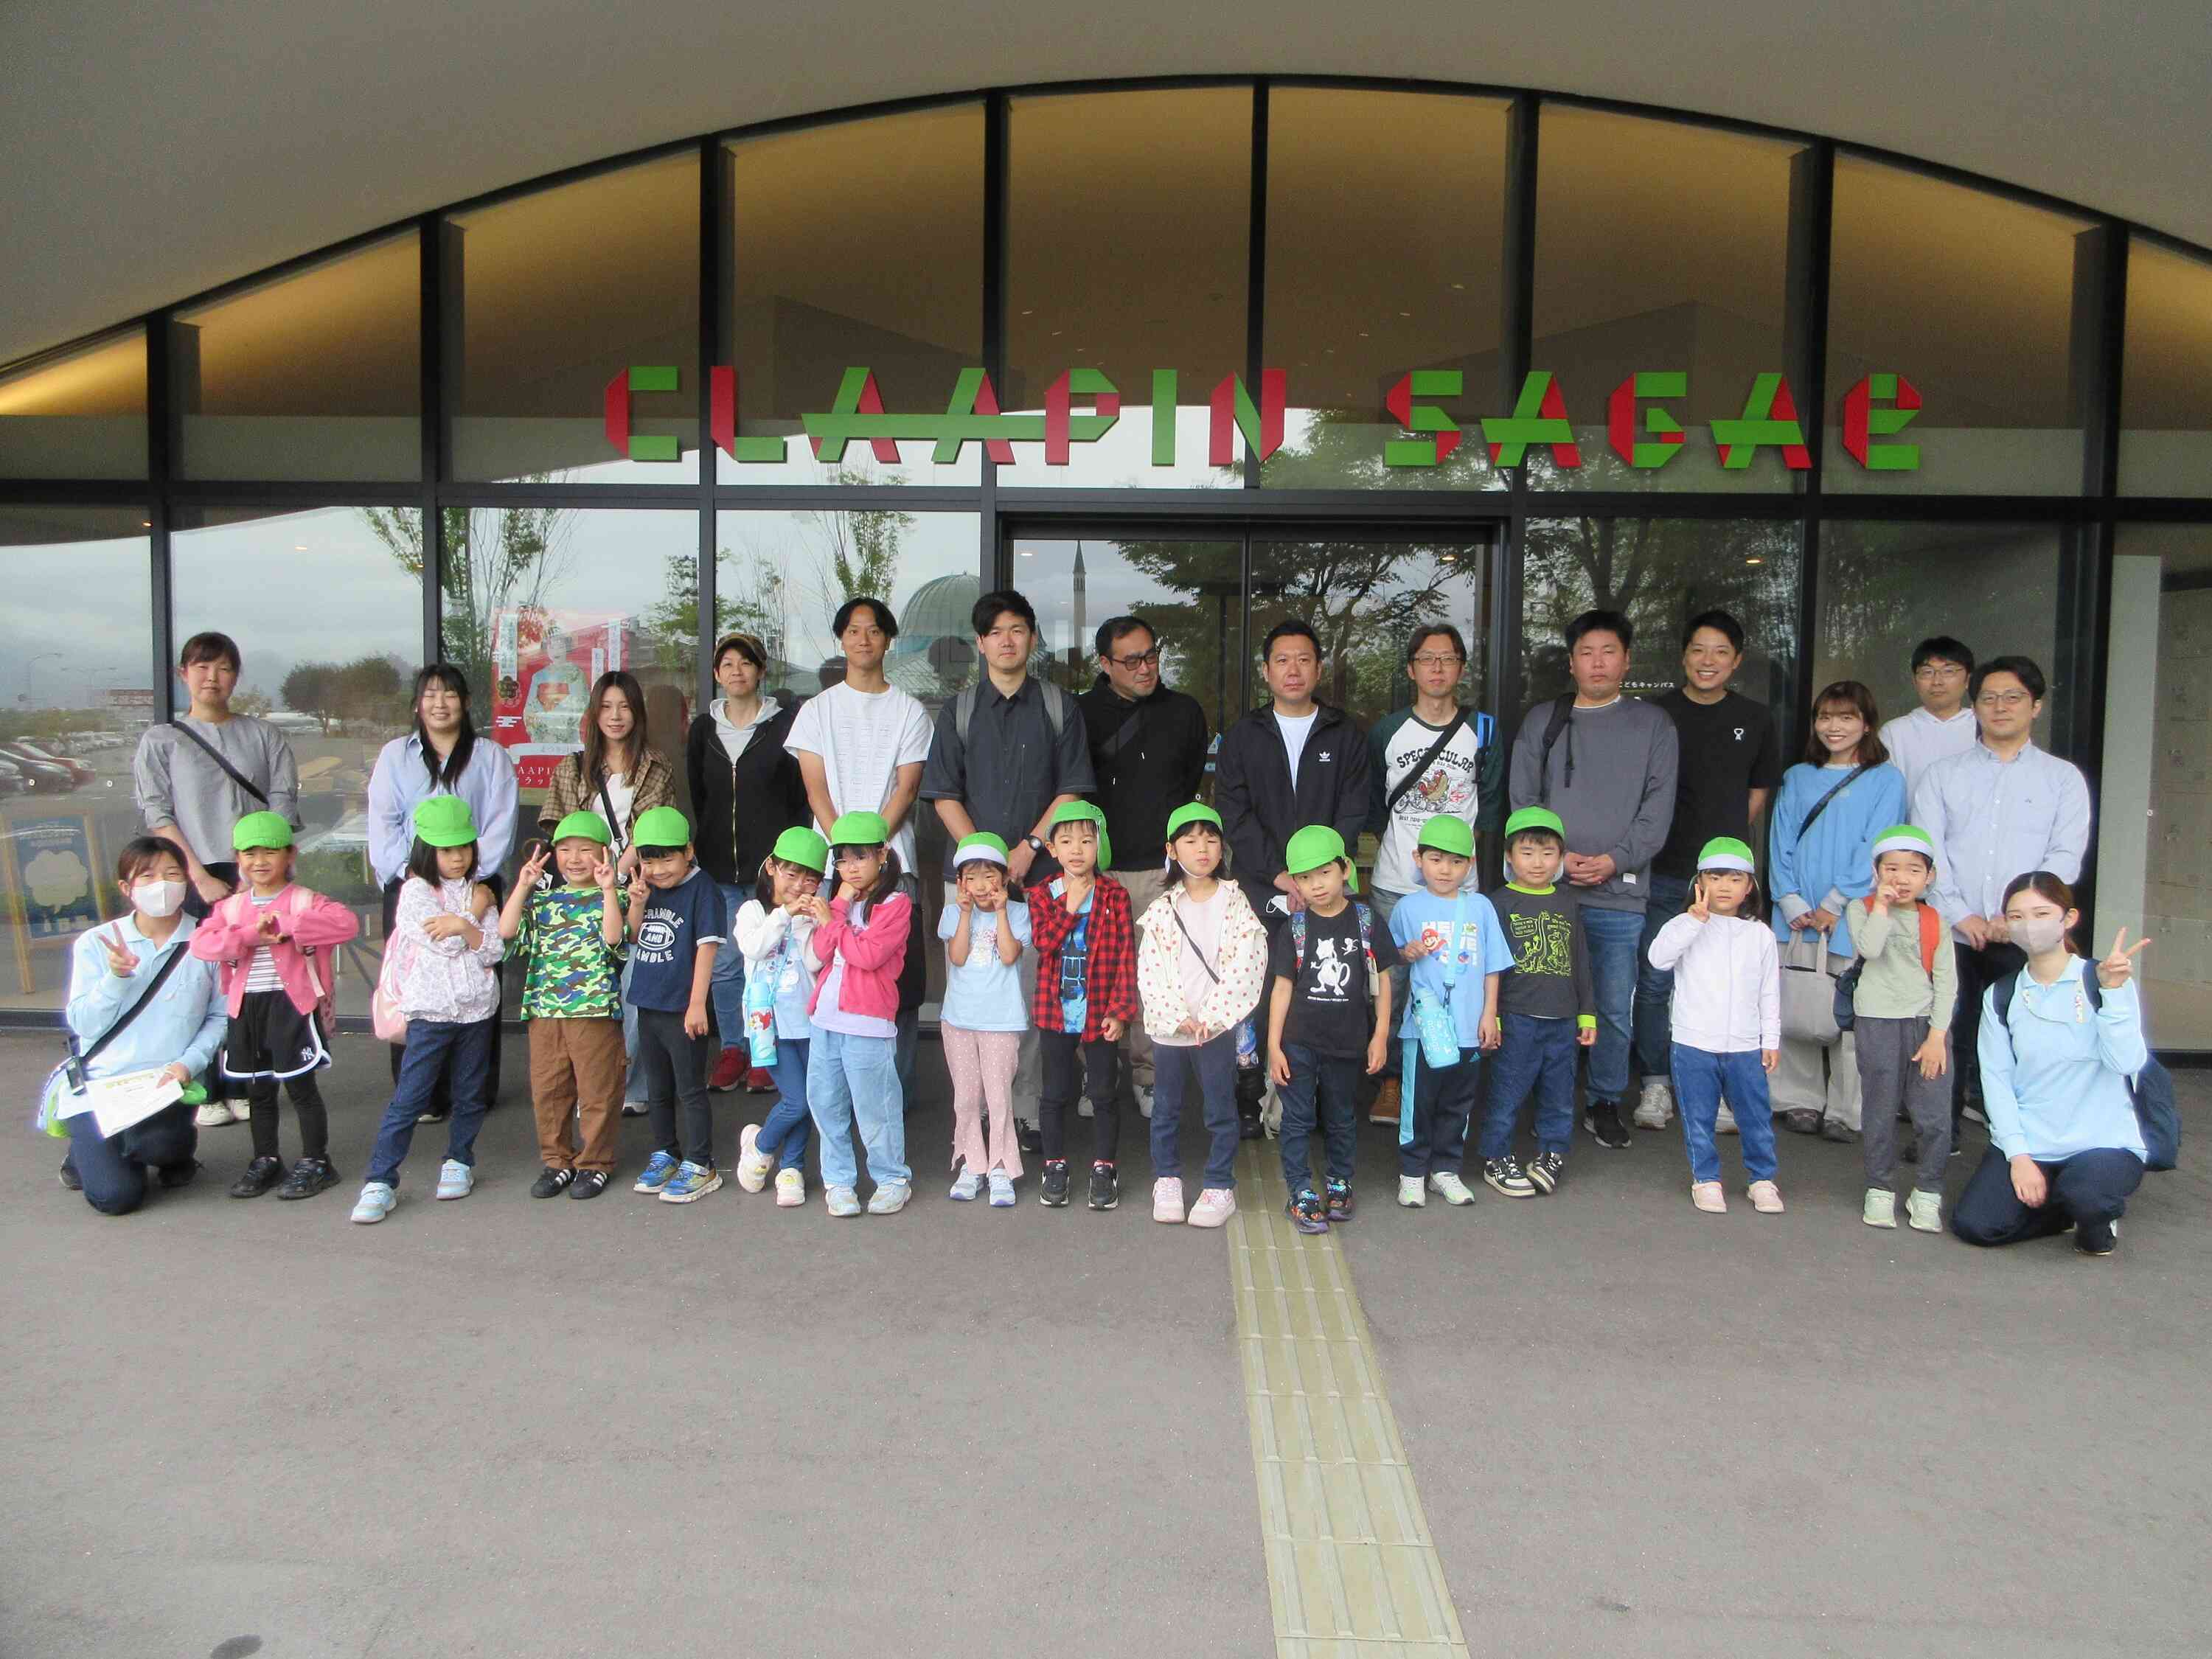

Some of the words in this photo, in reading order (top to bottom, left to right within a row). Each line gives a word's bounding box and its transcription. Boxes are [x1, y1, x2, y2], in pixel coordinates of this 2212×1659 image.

[605, 366, 1287, 466] CLAAPIN
[1397, 748, 1474, 773] SPECCULAR
[644, 932, 664, 944] AND
